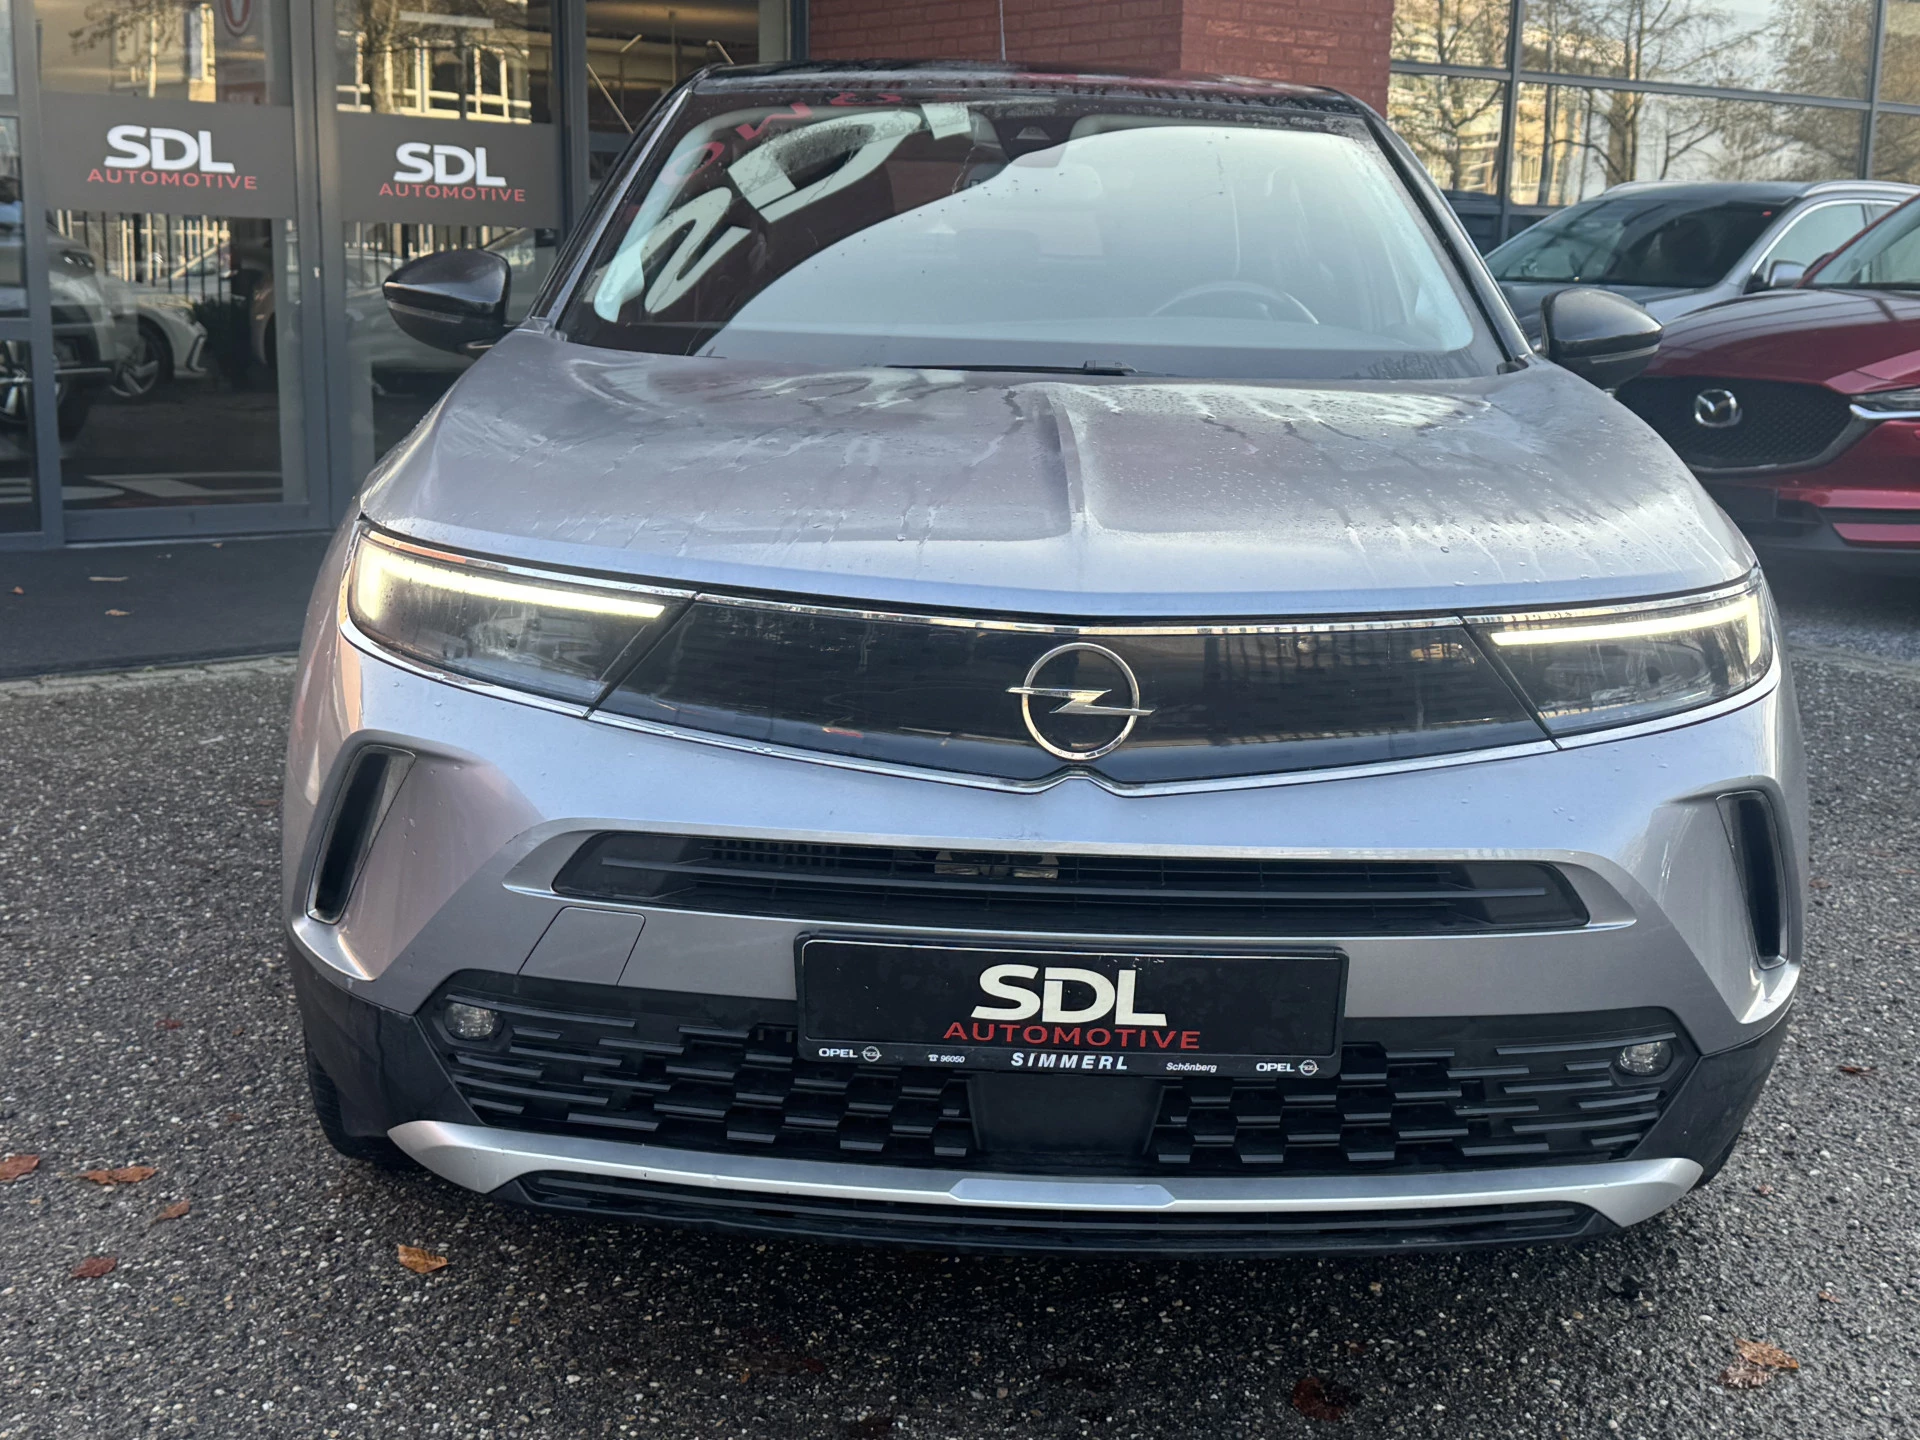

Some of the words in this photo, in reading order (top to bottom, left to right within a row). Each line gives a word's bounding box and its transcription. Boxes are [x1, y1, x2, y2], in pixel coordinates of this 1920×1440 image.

[104, 125, 236, 174] SDL
[393, 142, 507, 187] SDL
[87, 168, 258, 190] AUTOMOTIVE
[379, 183, 526, 202] AUTOMOTIVE
[970, 963, 1168, 1027] SDL
[943, 1021, 1201, 1049] AUTOMOTIVE
[818, 1048, 859, 1058] OPEL
[940, 1055, 965, 1063] 96050
[1011, 1052, 1128, 1070] SIMMERL
[1166, 1062, 1217, 1073] Schönberg
[1256, 1062, 1295, 1072] OPEL
